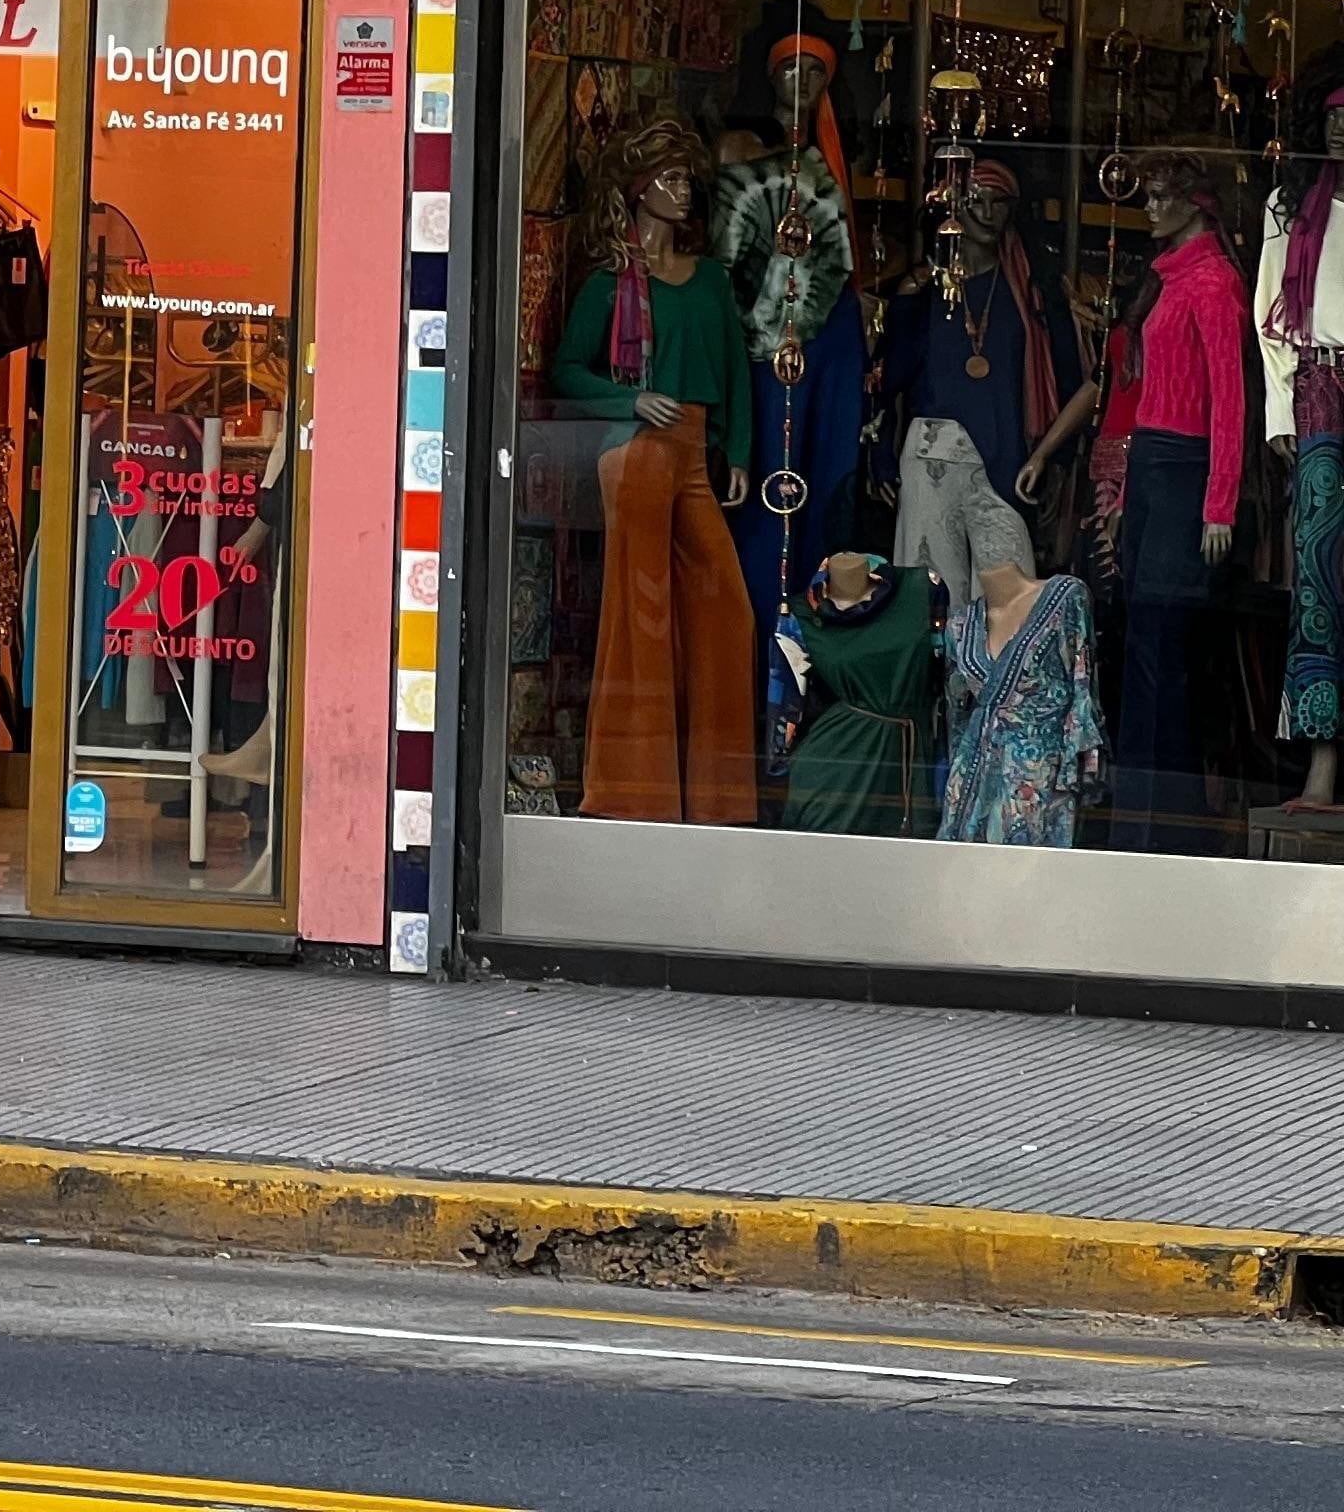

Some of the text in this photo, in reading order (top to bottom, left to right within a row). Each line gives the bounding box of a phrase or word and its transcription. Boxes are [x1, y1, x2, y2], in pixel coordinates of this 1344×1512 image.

[343, 40, 387, 49] verisure
[339, 55, 390, 69] Alarma
[108, 111, 284, 132] Av. Santa Fé 3441
[101, 292, 276, 317] www.byoung.com.ar
[108, 459, 257, 517] 3 cuotas
[183, 498, 256, 518] interés
[104, 544, 258, 633] 20%
[103, 634, 256, 660] DESCUENTO
